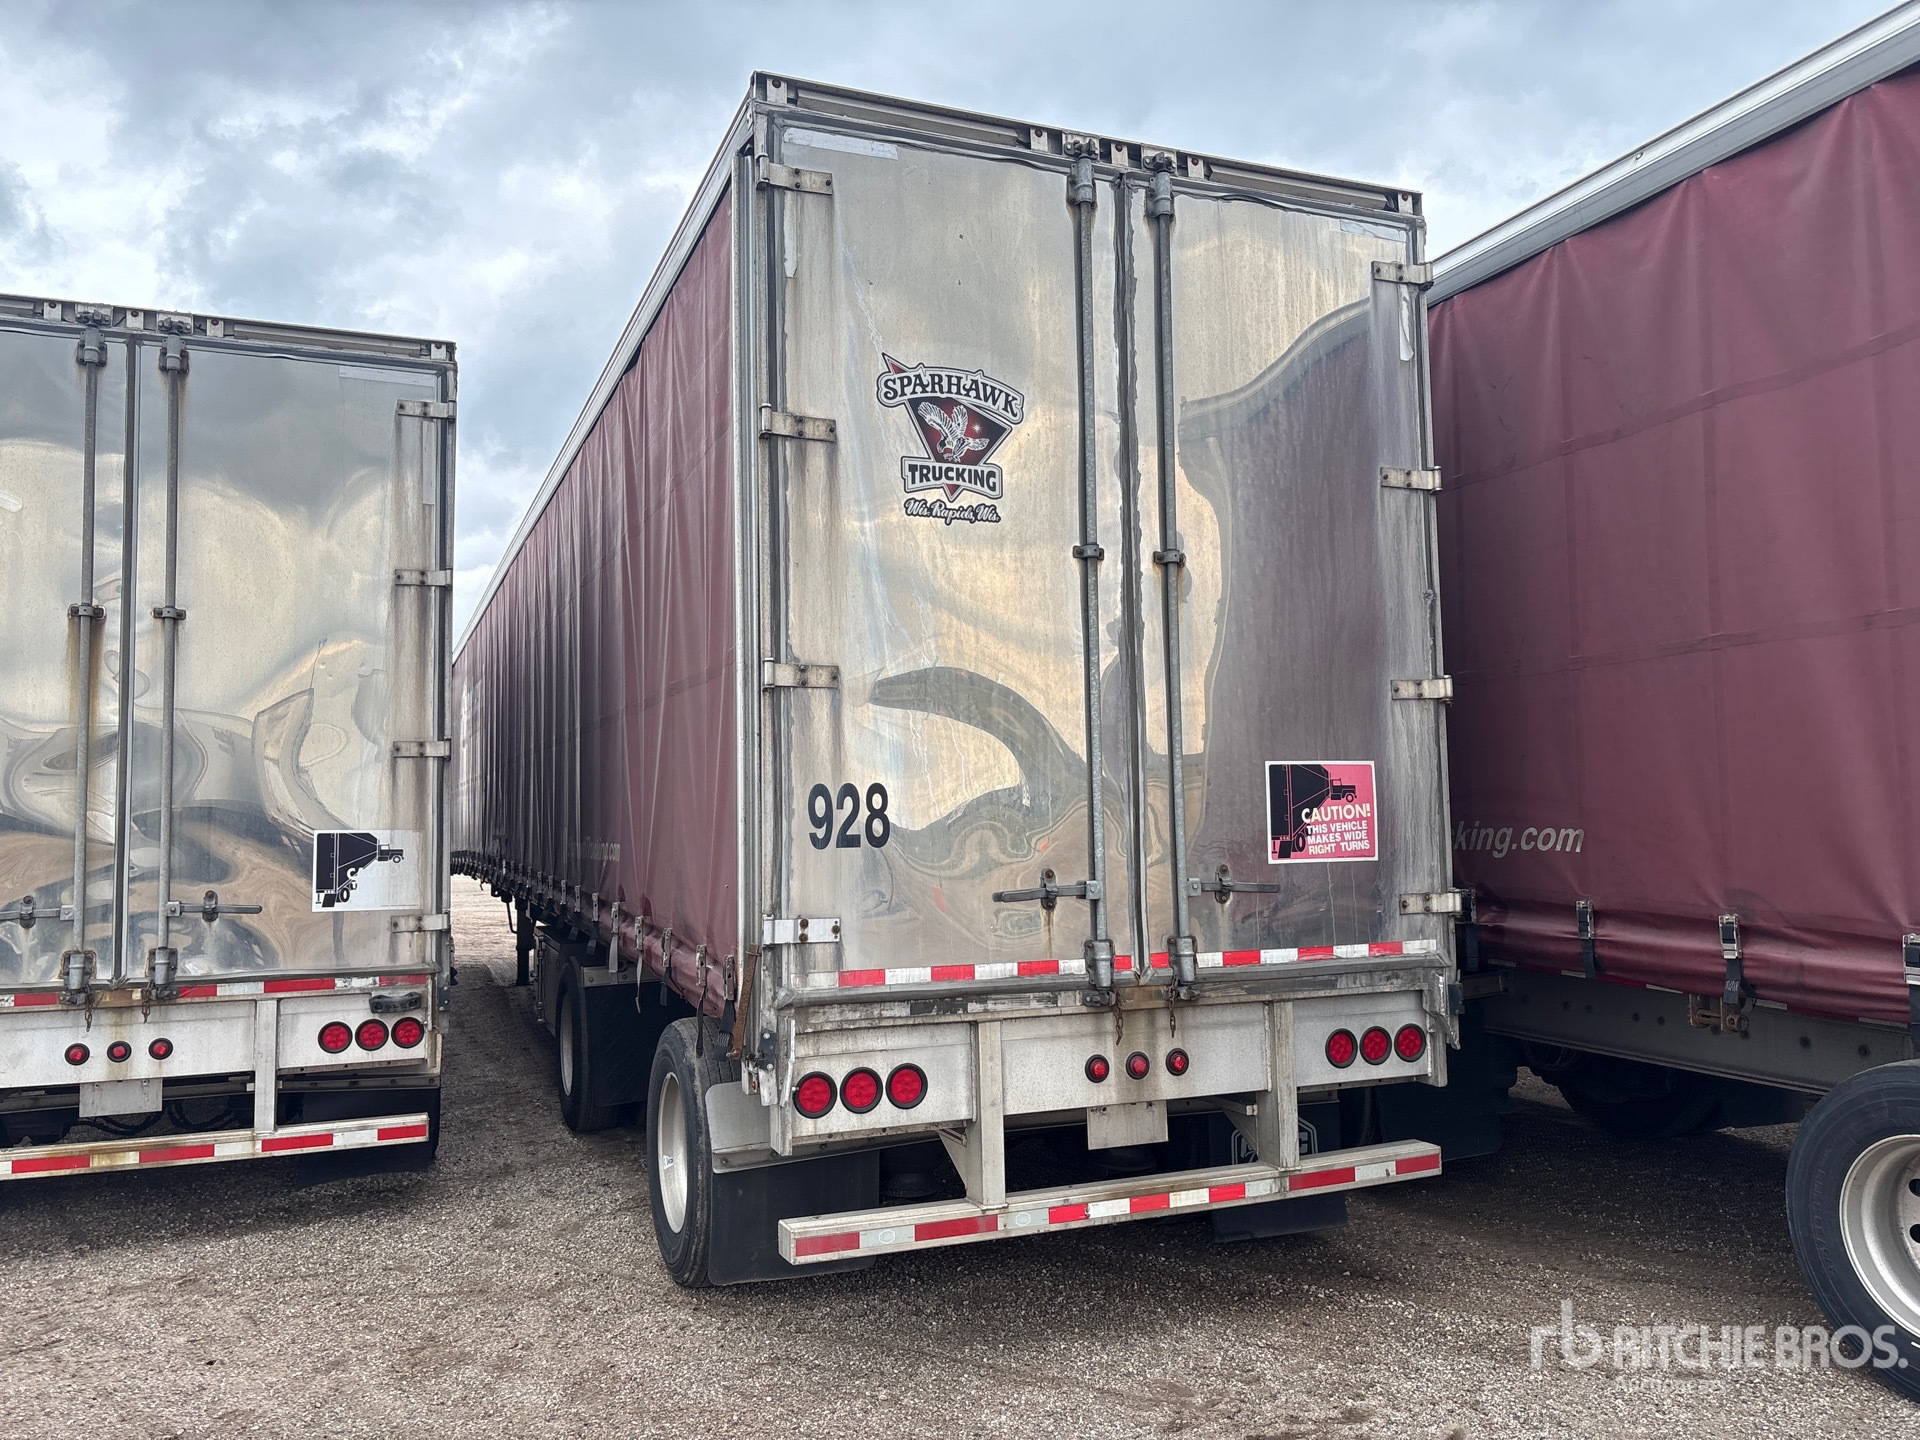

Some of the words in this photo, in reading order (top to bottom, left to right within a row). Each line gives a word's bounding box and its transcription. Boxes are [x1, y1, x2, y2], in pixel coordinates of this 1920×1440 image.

[883, 373, 1018, 418] SPARHAWK
[908, 464, 997, 492] TRUCKING
[906, 500, 931, 516] Wis.
[976, 505, 1000, 522] Wis.
[807, 782, 890, 850] 928
[1301, 803, 1371, 823] CAUTION!
[1306, 824, 1328, 835] THIS
[1330, 820, 1368, 832] VEHICLE
[1307, 833, 1341, 845] MAKES
[1343, 830, 1368, 841] WIDE
[1308, 843, 1336, 855] RIGHT
[1340, 840, 1370, 852] TURNS
[1451, 820, 1585, 858] king.com
